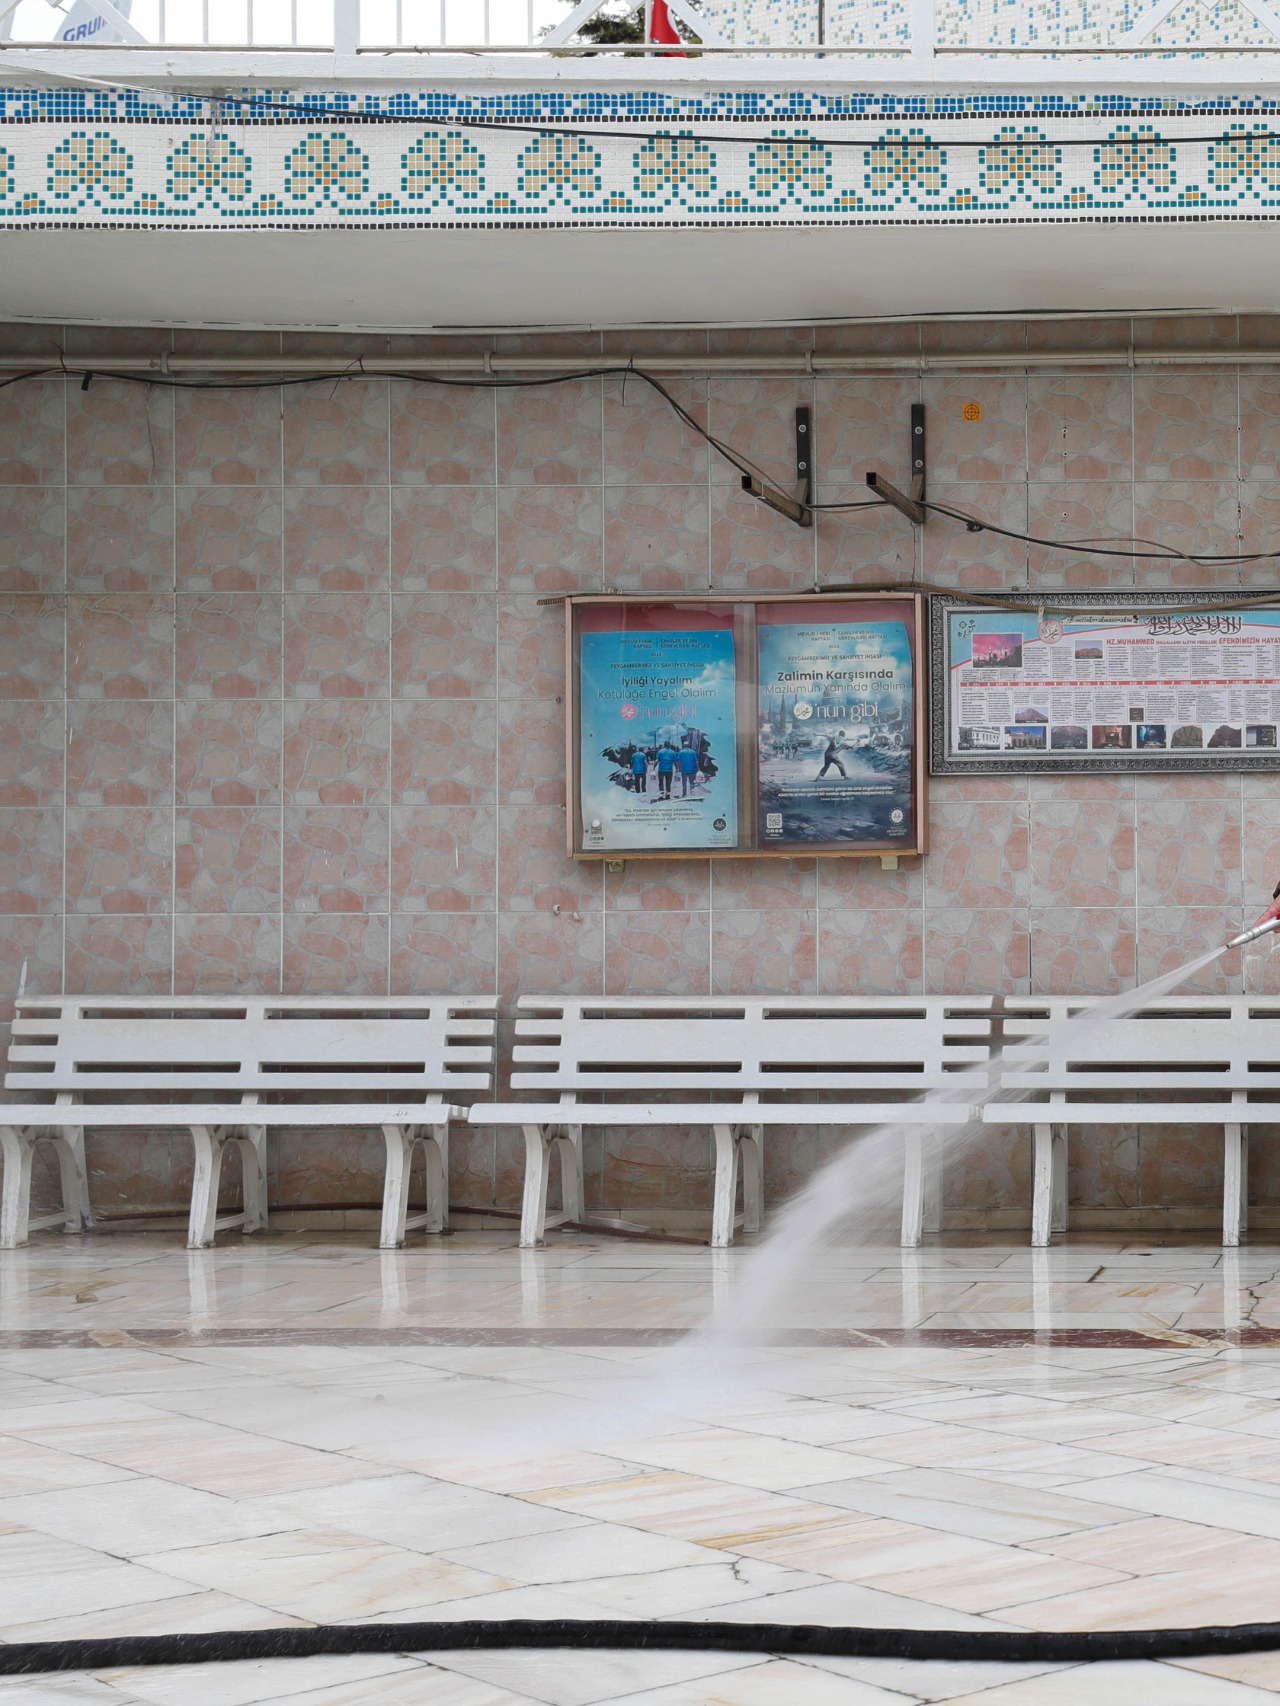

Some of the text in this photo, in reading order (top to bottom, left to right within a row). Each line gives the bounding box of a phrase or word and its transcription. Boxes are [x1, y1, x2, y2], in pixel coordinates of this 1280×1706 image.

[777, 669, 894, 682] Zalimin Karşısında
[621, 676, 692, 688] İyiliği Yayalım
[765, 682, 906, 694] Mazlumun Yanında Olalım
[649, 688, 678, 700] Engel
[681, 688, 717, 698] Olalım
